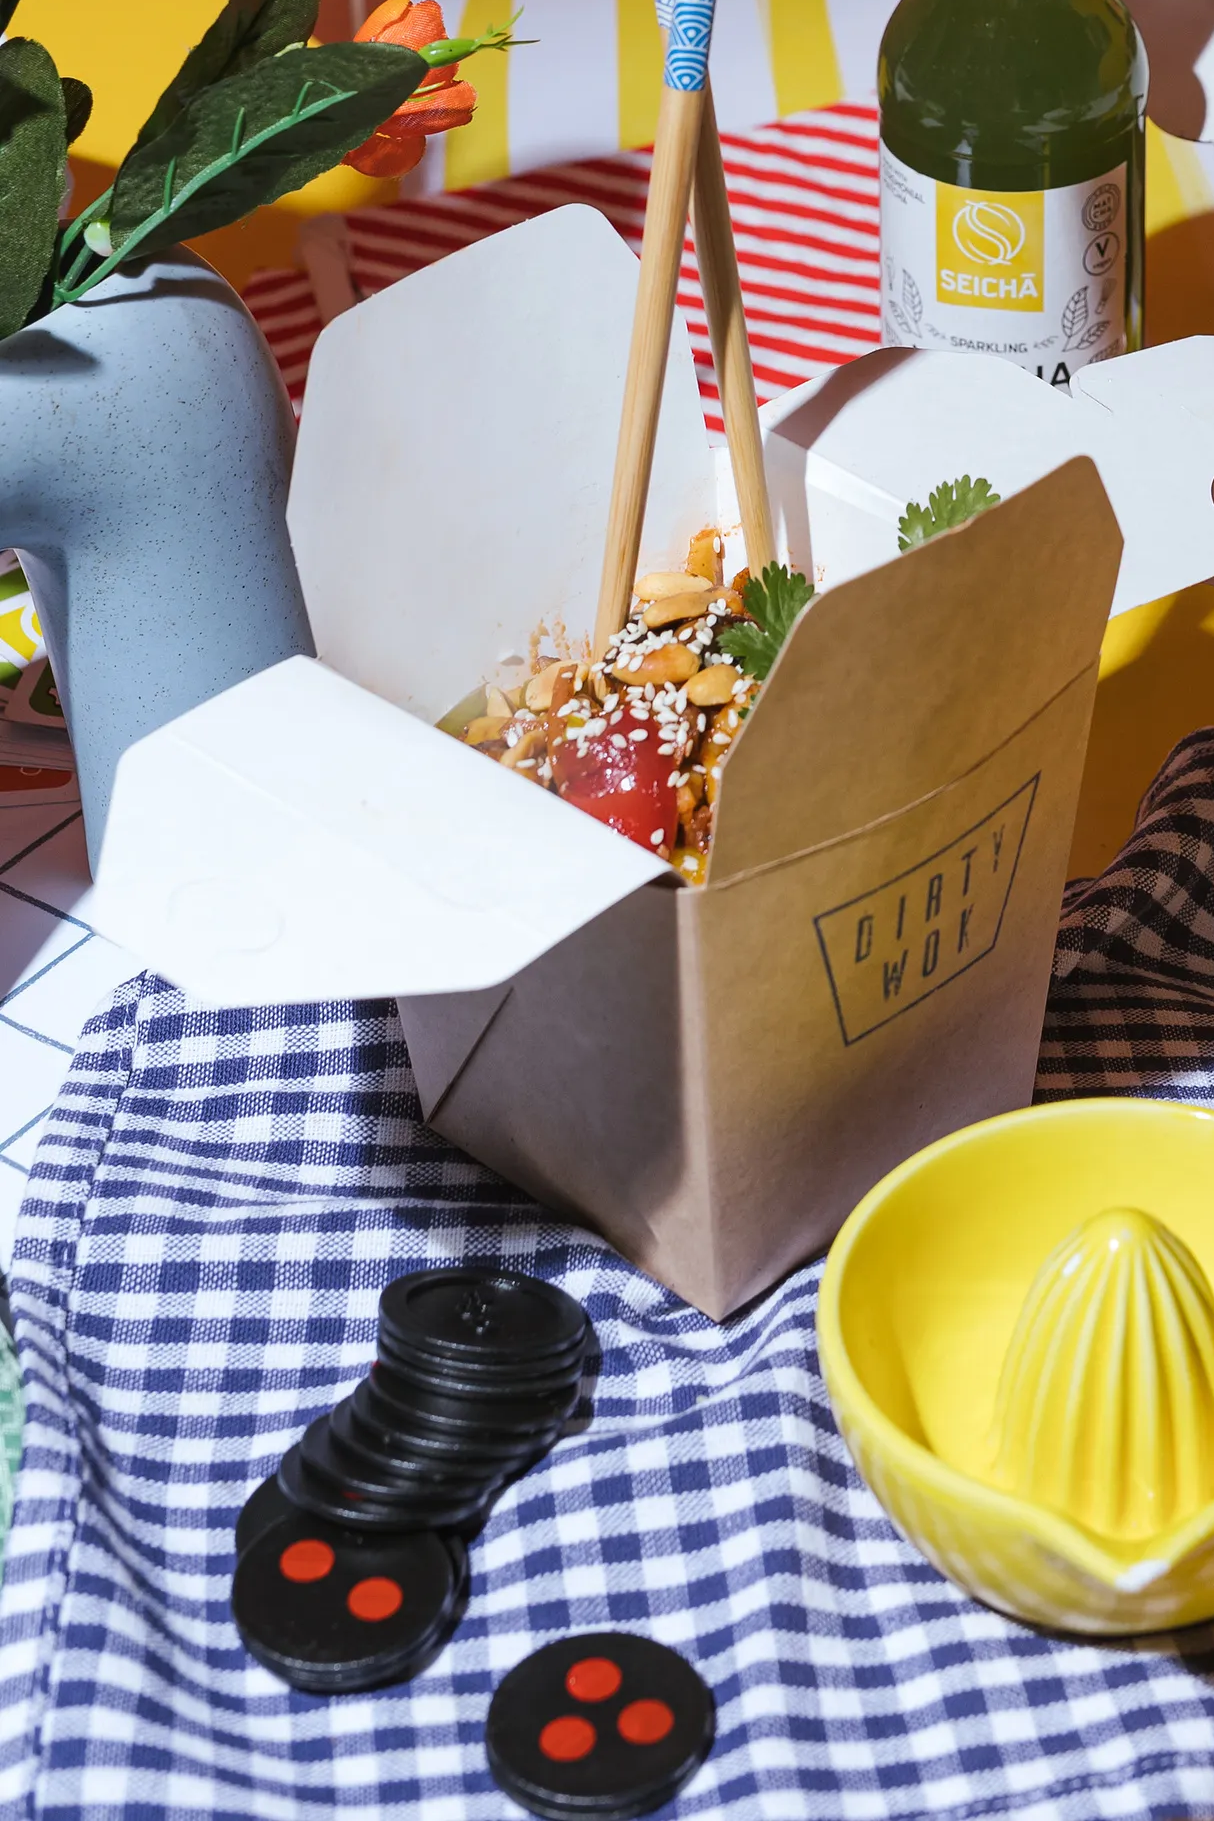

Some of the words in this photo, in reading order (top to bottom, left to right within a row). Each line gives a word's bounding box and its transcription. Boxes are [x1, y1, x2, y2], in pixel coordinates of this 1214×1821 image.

[940, 268, 1039, 299] SEICHĀ
[950, 335, 1028, 354] SPARKLING
[855, 828, 1004, 963] DIRTY
[883, 905, 974, 1000] WOK
